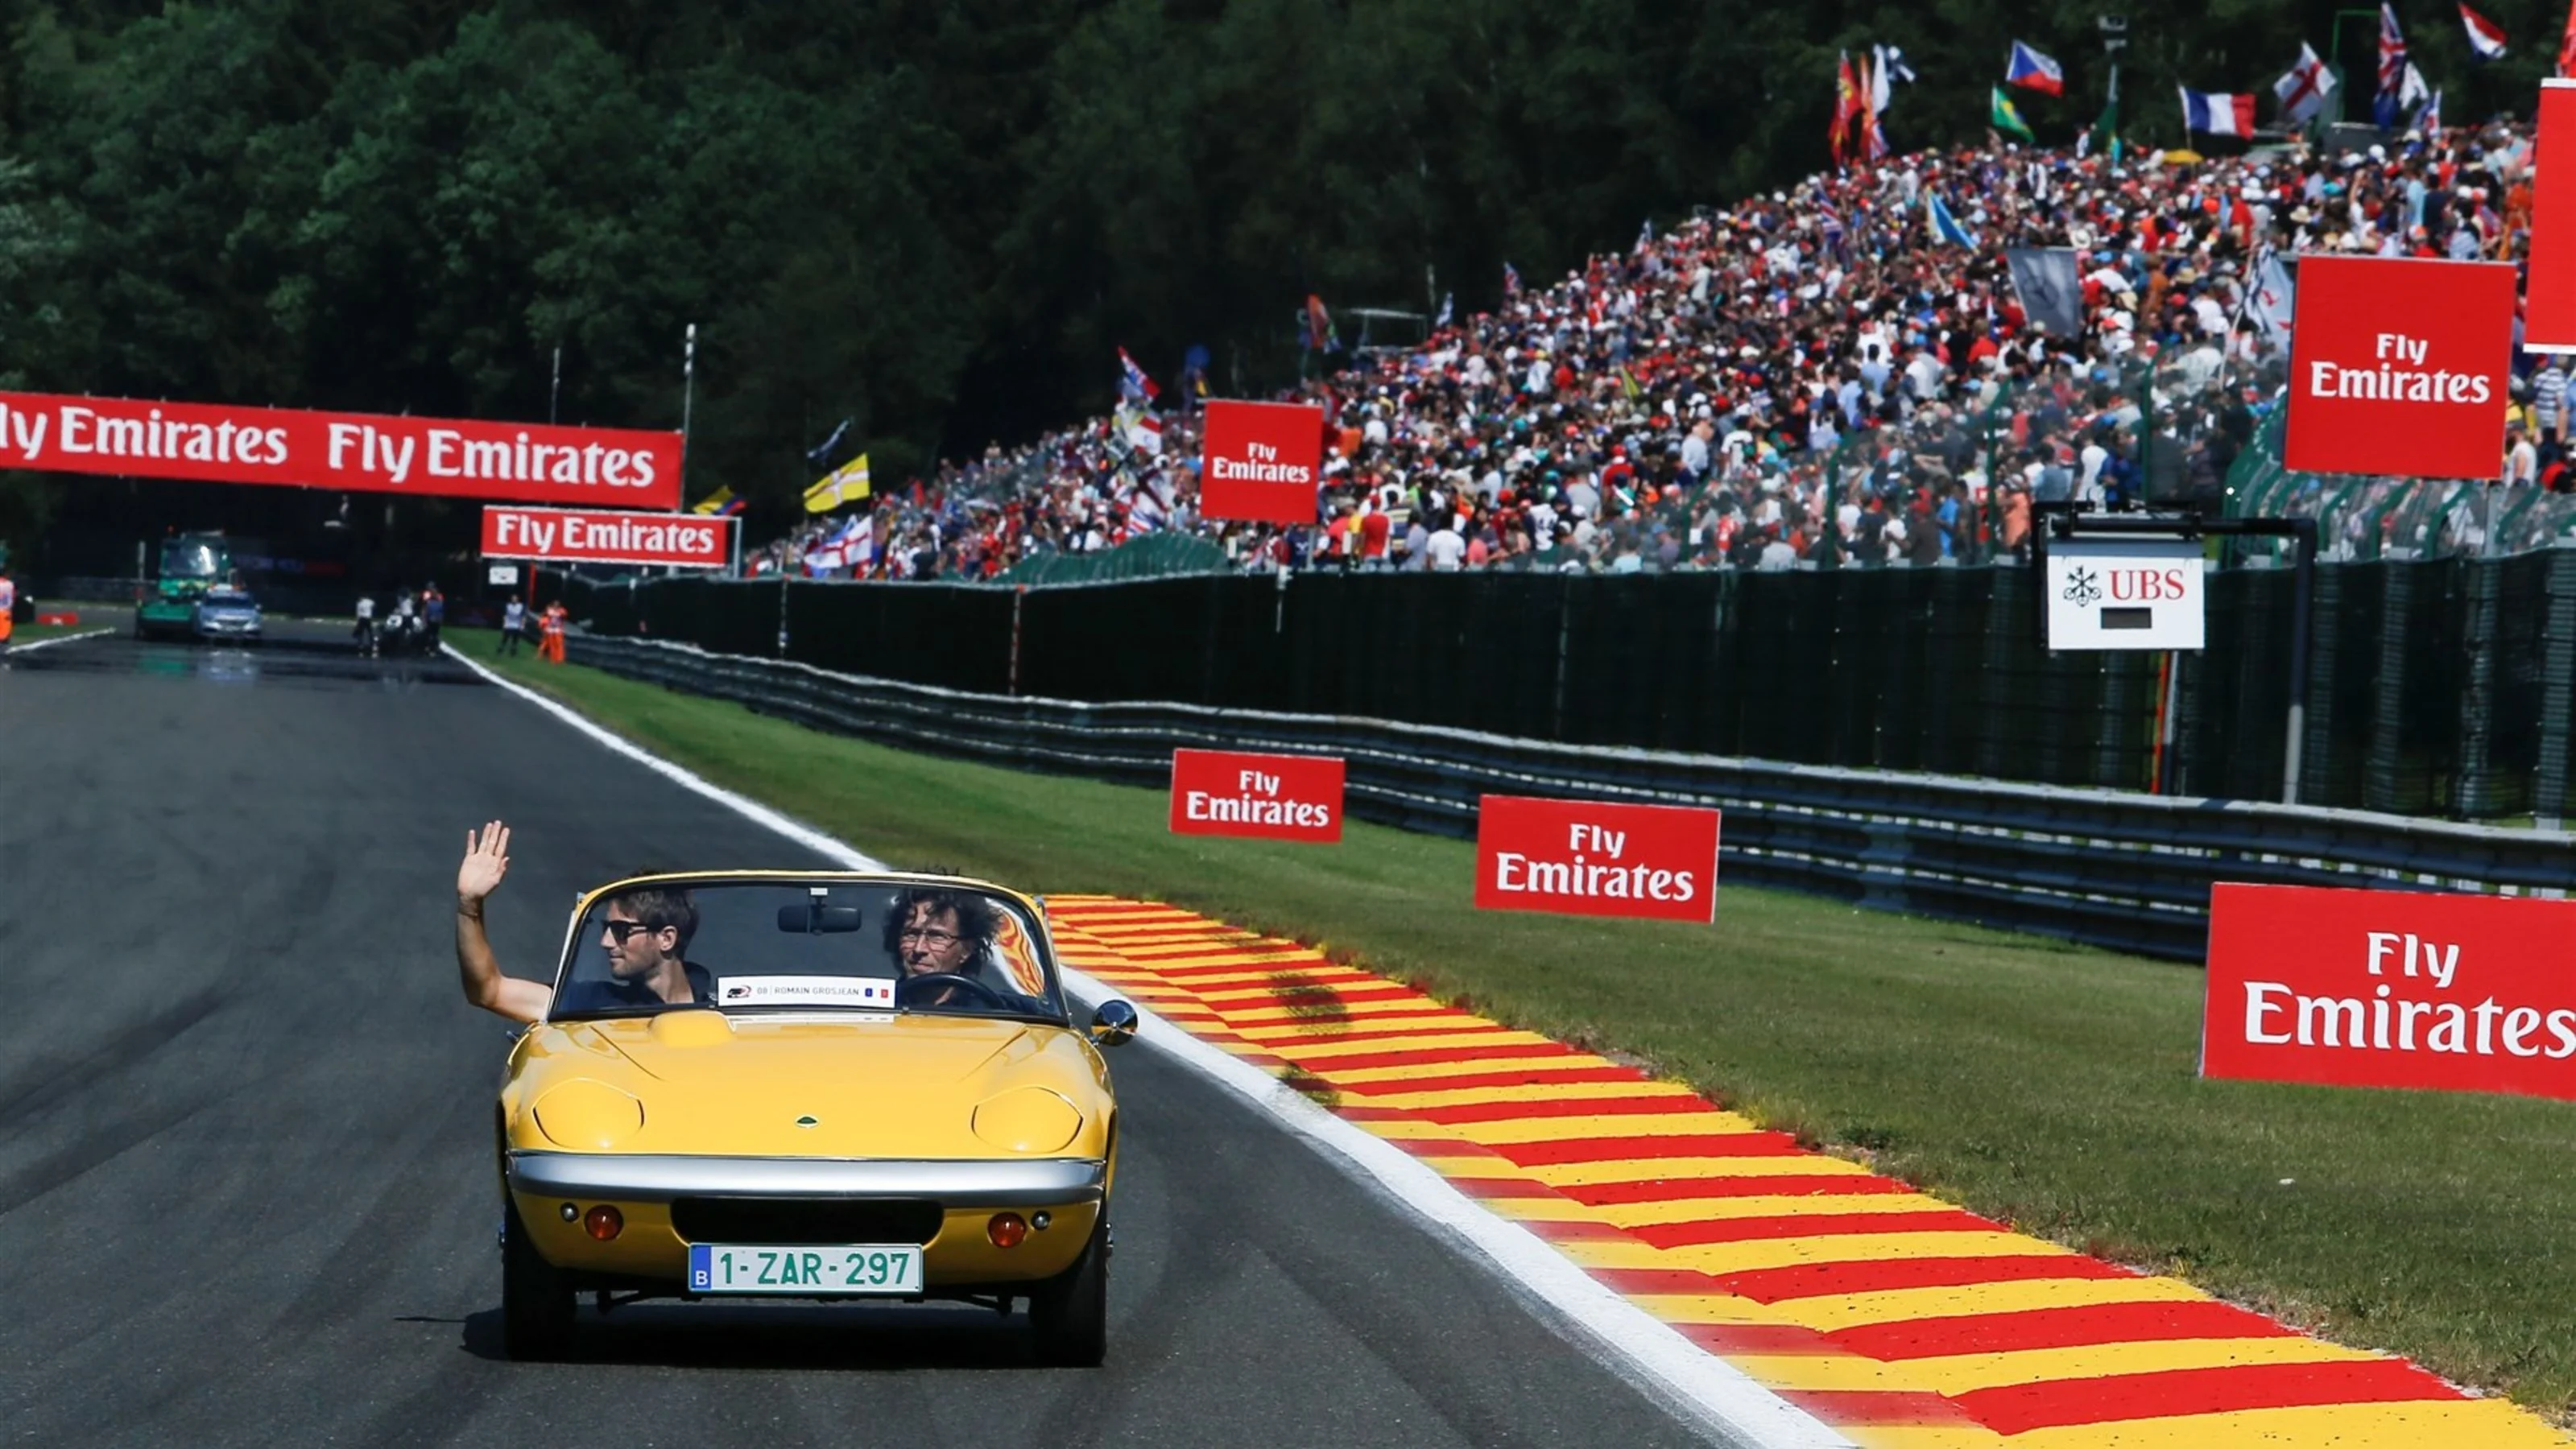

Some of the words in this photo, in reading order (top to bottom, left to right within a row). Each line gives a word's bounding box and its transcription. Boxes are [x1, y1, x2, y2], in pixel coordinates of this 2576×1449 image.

[2377, 333, 2429, 366] Fly
[2310, 361, 2491, 404] Emirates
[60, 406, 289, 466] Emirates
[1247, 442, 1277, 463] Fly
[328, 423, 416, 483] Fly
[427, 428, 655, 489] Emirates
[1212, 456, 1310, 484] Emirates
[497, 513, 556, 555] Fly
[562, 516, 715, 555] Emirates
[2108, 568, 2185, 601] UBS
[1239, 770, 1280, 797] Fly
[1186, 791, 1329, 828] Emirates
[1569, 823, 1626, 859] Fly
[1496, 852, 1694, 902] Emirates
[2367, 931, 2460, 989] Fly
[774, 986, 810, 995] ROMAIN
[812, 986, 859, 996] GROSJEAN
[2243, 981, 2576, 1059] Emirates
[694, 1270, 709, 1286] B
[720, 1252, 910, 1285] 1-ZAR-297
